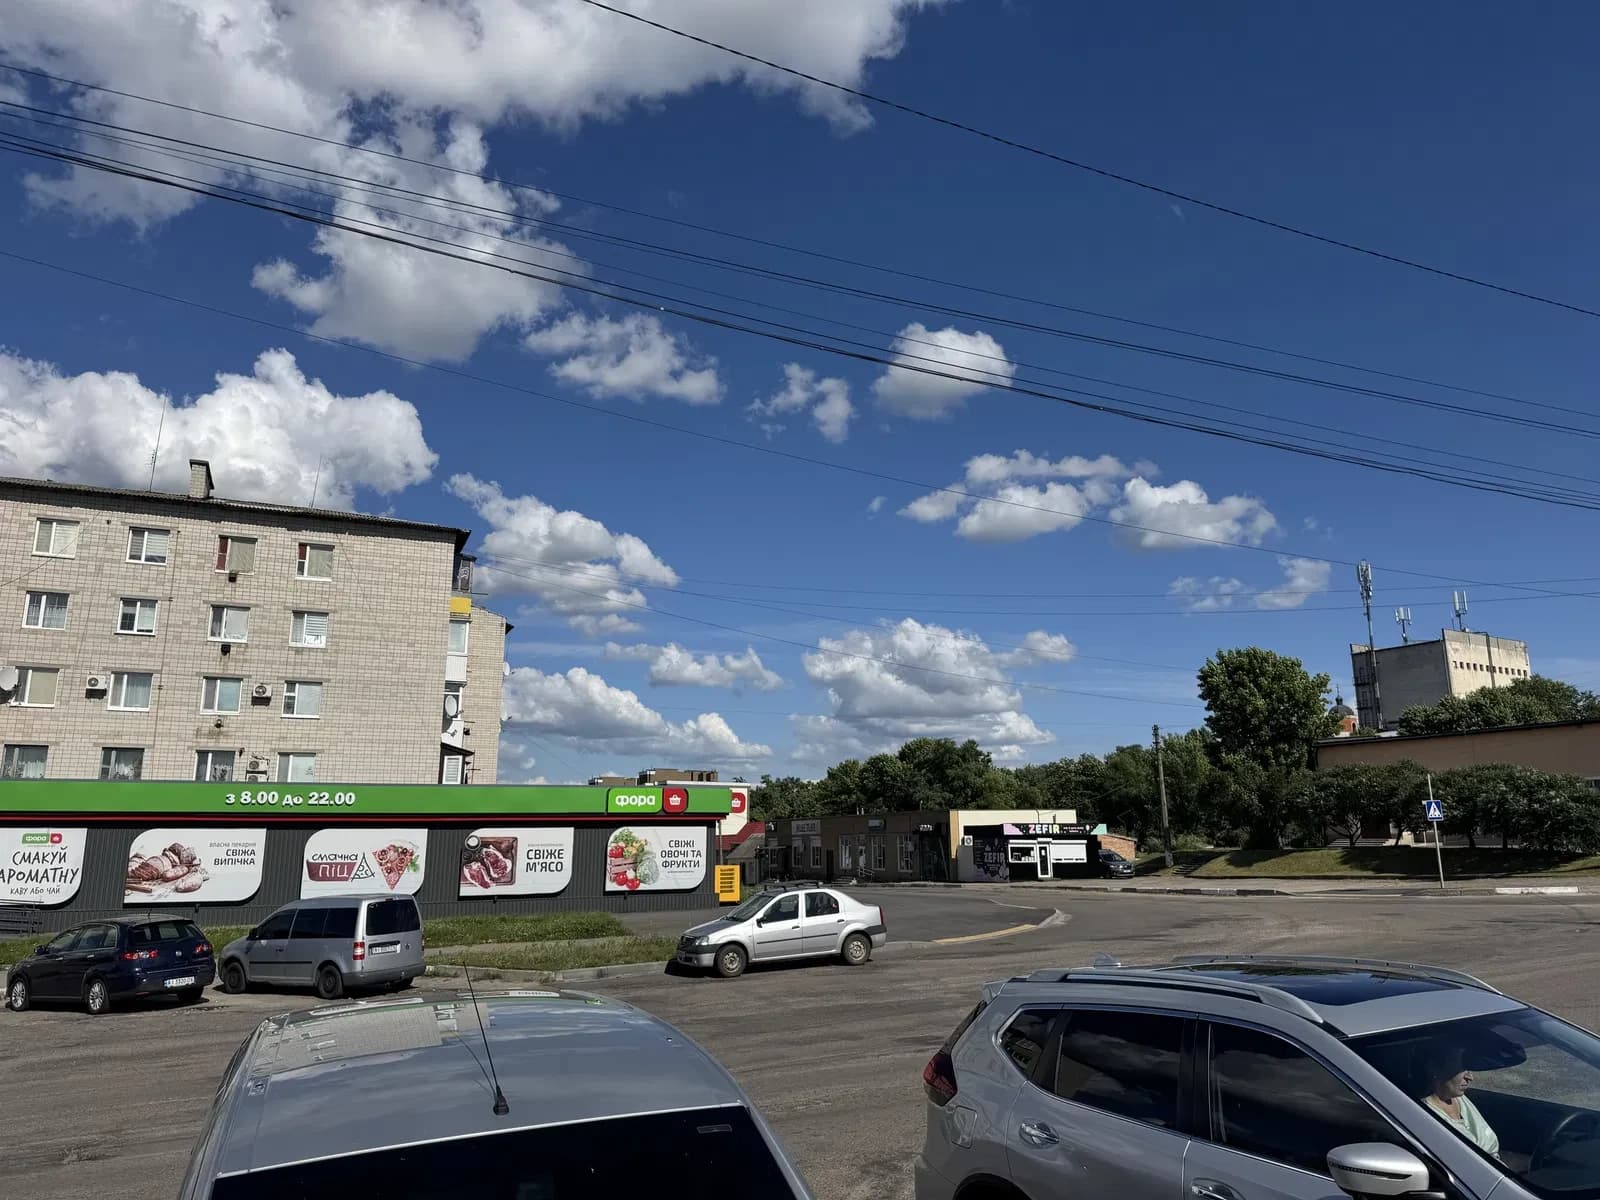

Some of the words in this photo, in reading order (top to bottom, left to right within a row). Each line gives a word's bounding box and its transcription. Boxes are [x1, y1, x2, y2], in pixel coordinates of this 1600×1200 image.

[240, 791, 279, 805] 8.00
[307, 792, 356, 805] 22.00
[1028, 824, 1060, 834] ZEFIR
[668, 839, 695, 848] СВІЖІ
[12, 846, 68, 866] СМАКУЙ
[225, 848, 256, 857] СВІЖА
[526, 848, 565, 860] СВІЖЕ
[660, 849, 689, 858] ОВОЧІ
[690, 849, 702, 858] ТА
[213, 857, 256, 866] ВИПІЧКА
[661, 860, 700, 868] ФРУКТИ
[525, 861, 564, 873] М'ЯСО
